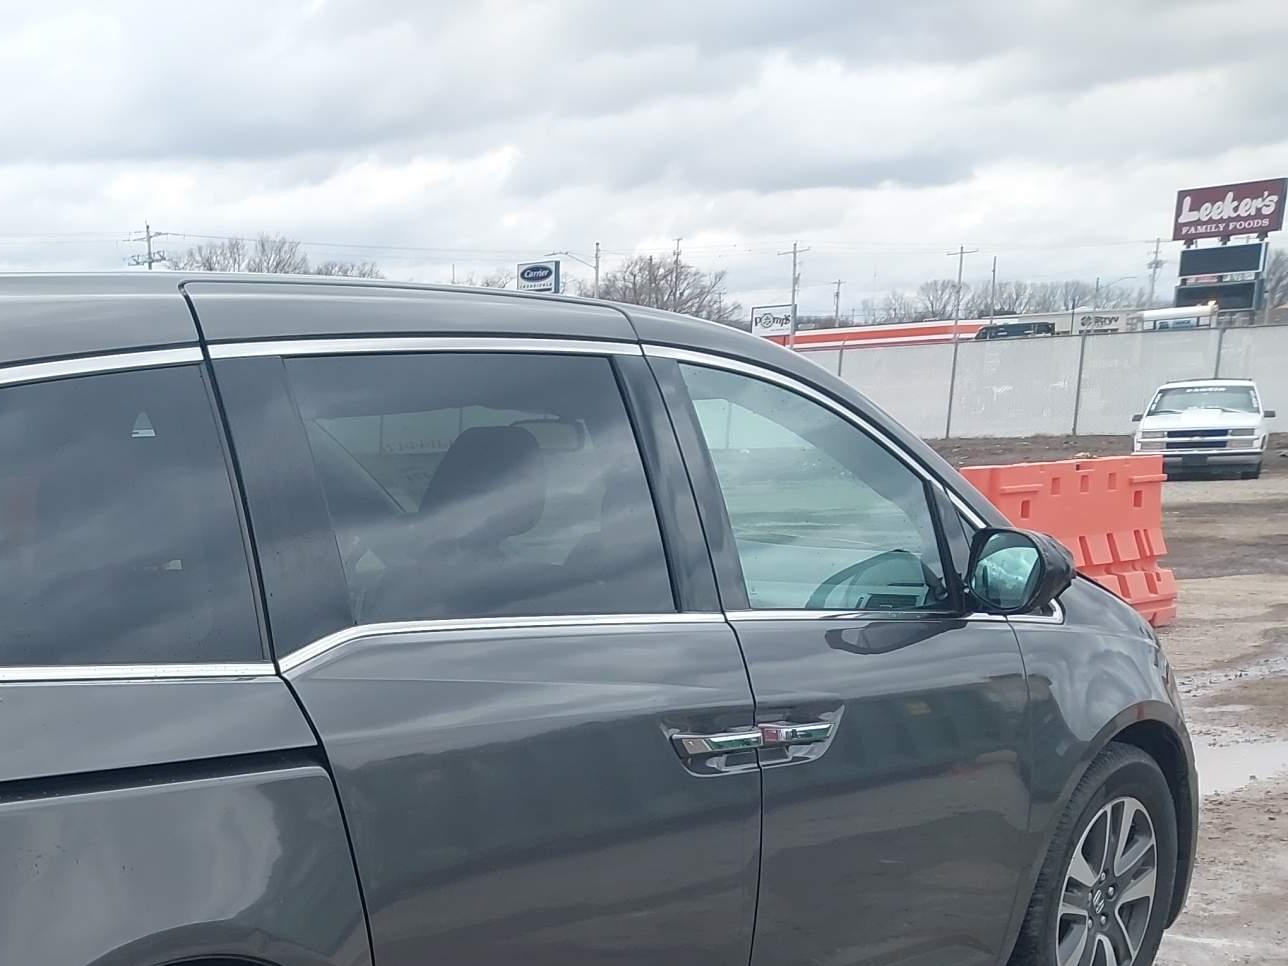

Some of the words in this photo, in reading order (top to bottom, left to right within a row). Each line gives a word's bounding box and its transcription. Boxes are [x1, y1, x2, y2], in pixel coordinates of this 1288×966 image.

[1177, 191, 1279, 224] Leeker's
[1181, 223, 1226, 235] FAMILY
[1228, 218, 1270, 231] FOODS
[524, 268, 550, 278] Carrier
